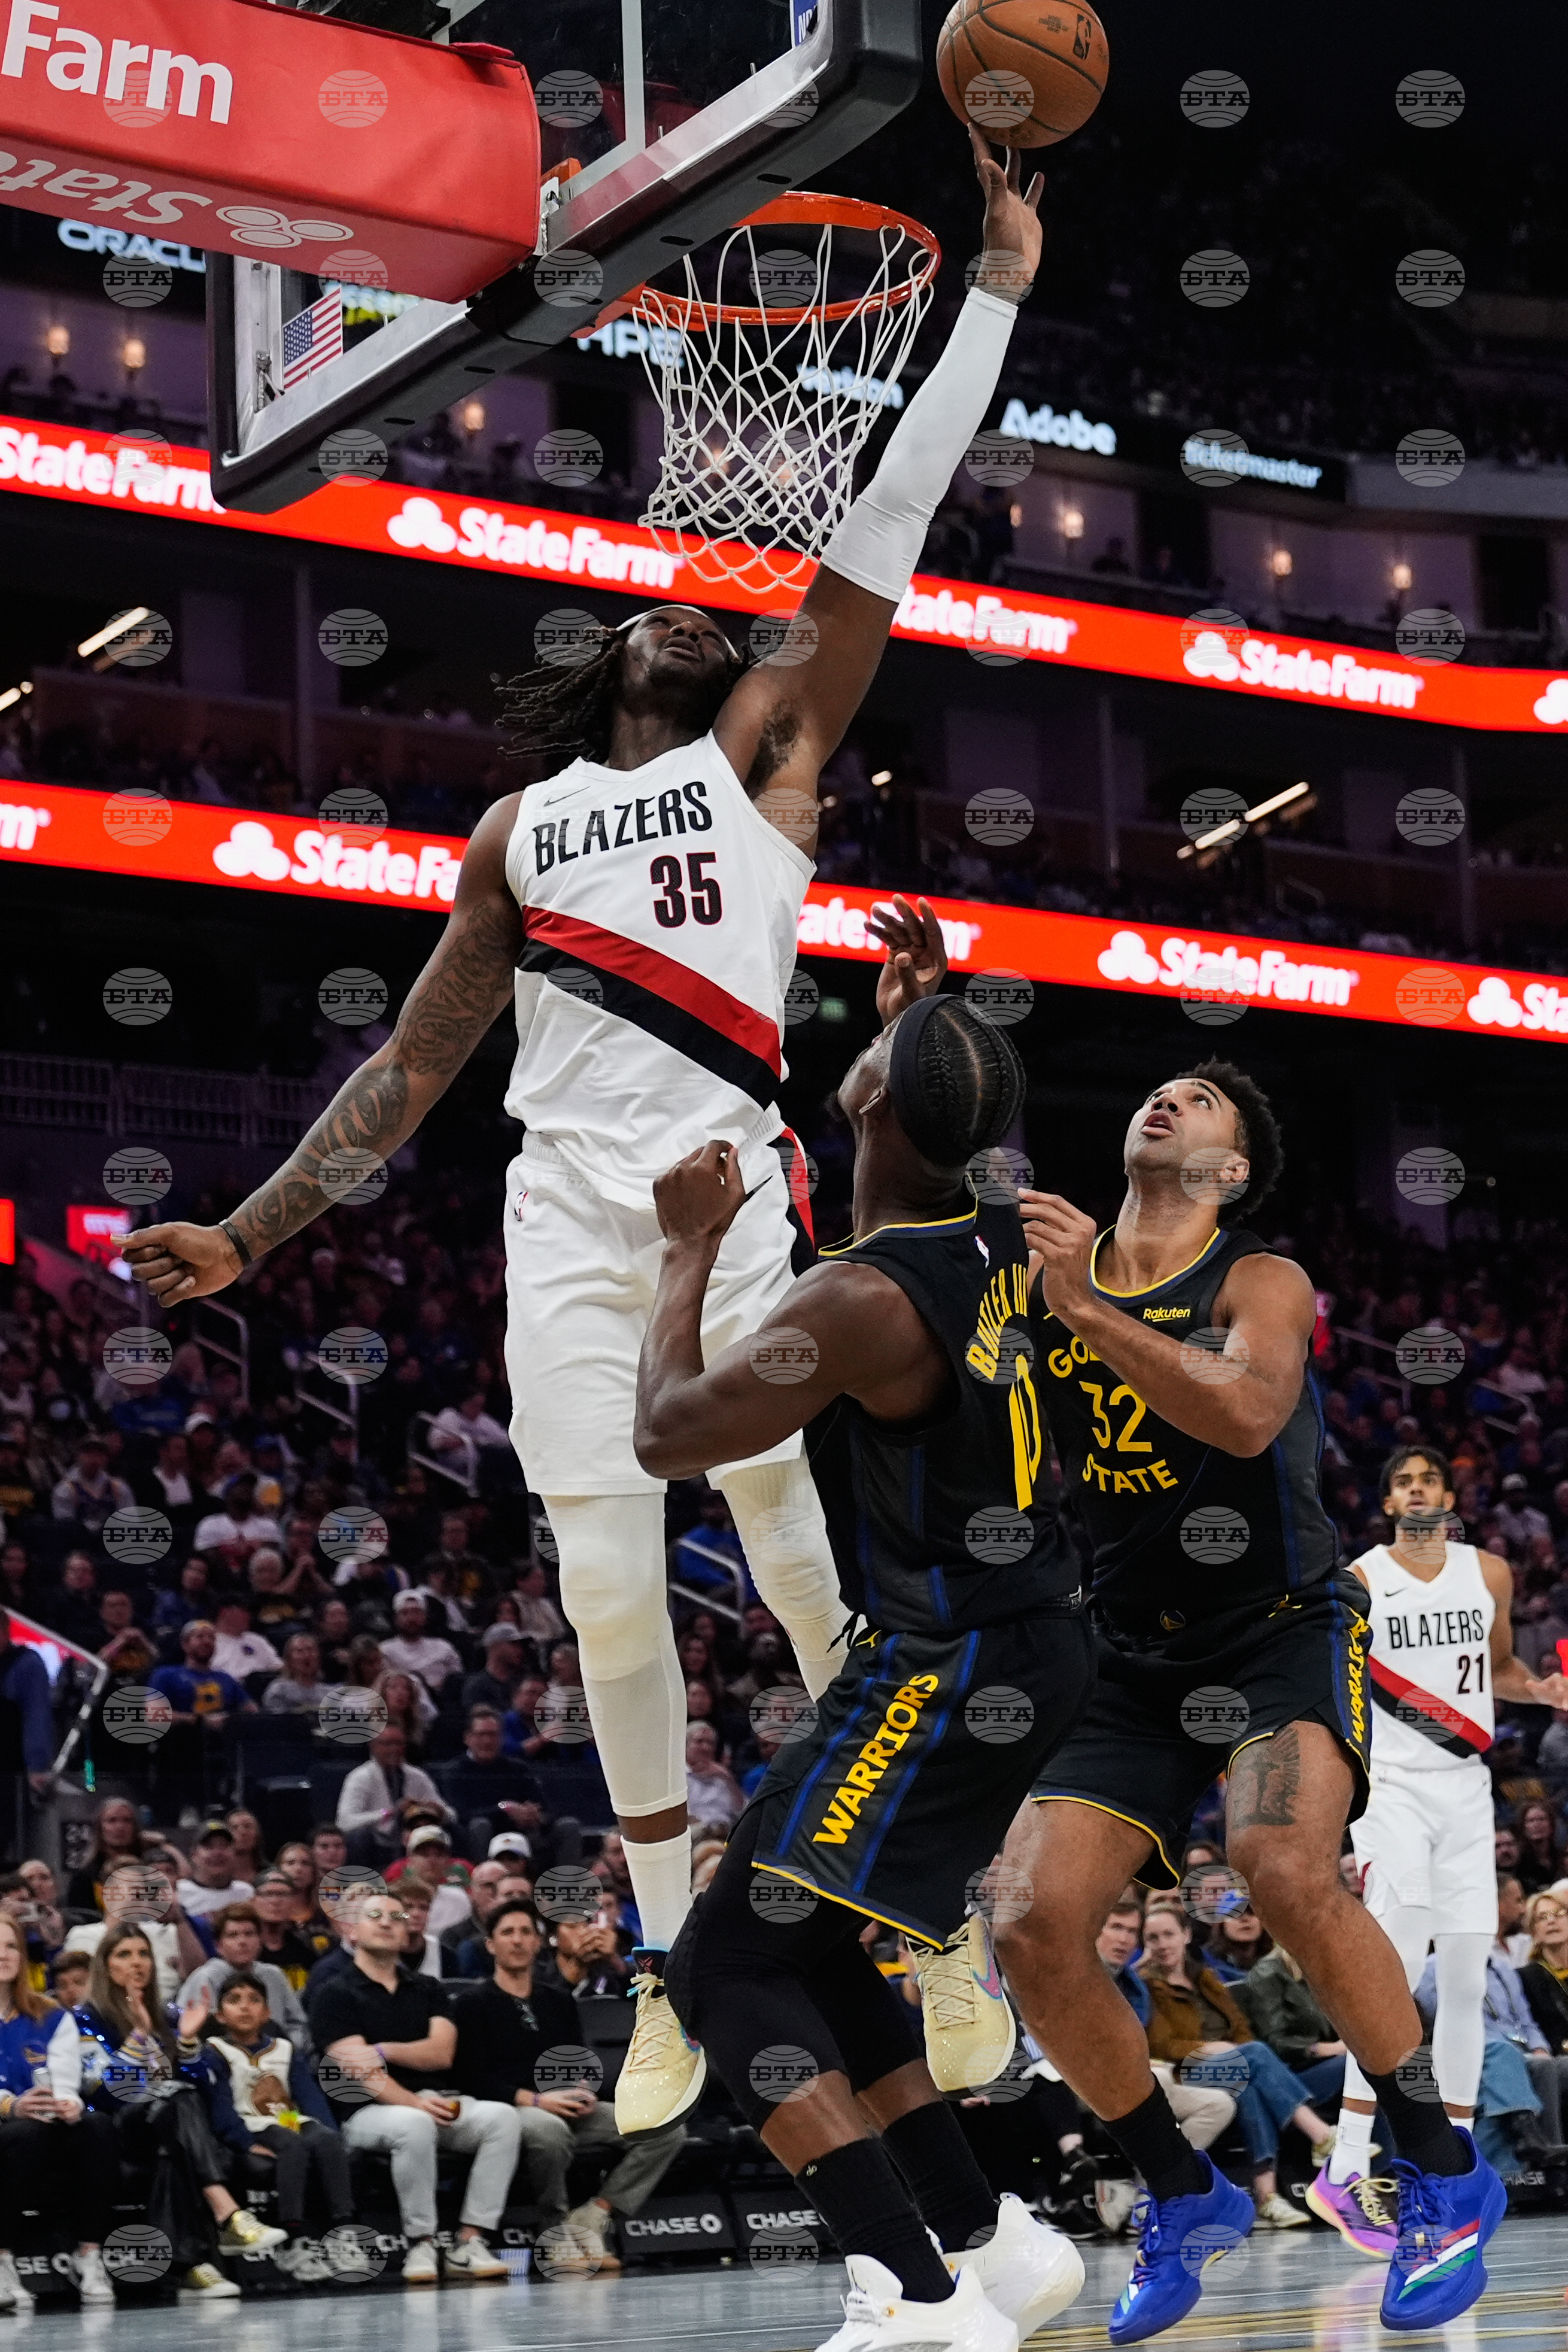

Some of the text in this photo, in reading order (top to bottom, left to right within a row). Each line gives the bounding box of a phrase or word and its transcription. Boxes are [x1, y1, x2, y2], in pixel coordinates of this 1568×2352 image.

[1, 0, 233, 124] Farm
[57, 218, 206, 273] ORACL
[999, 397, 1117, 456] Adobe
[892, 583, 1069, 654] tateFarm
[532, 781, 712, 876] BLAZERS
[290, 829, 462, 902] StateFa
[650, 852, 722, 928] 35
[1143, 1307, 1190, 1322] Rakuten
[1078, 1381, 1153, 1452] 32
[1082, 1453, 1178, 1494] STATE
[1385, 1609, 1484, 1649] BLAZERS
[1457, 1653, 1485, 1695] 21
[813, 1674, 939, 1846] WARRIORS
[625, 2217, 701, 2236] CHASE
[746, 2210, 821, 2230] CHASE
